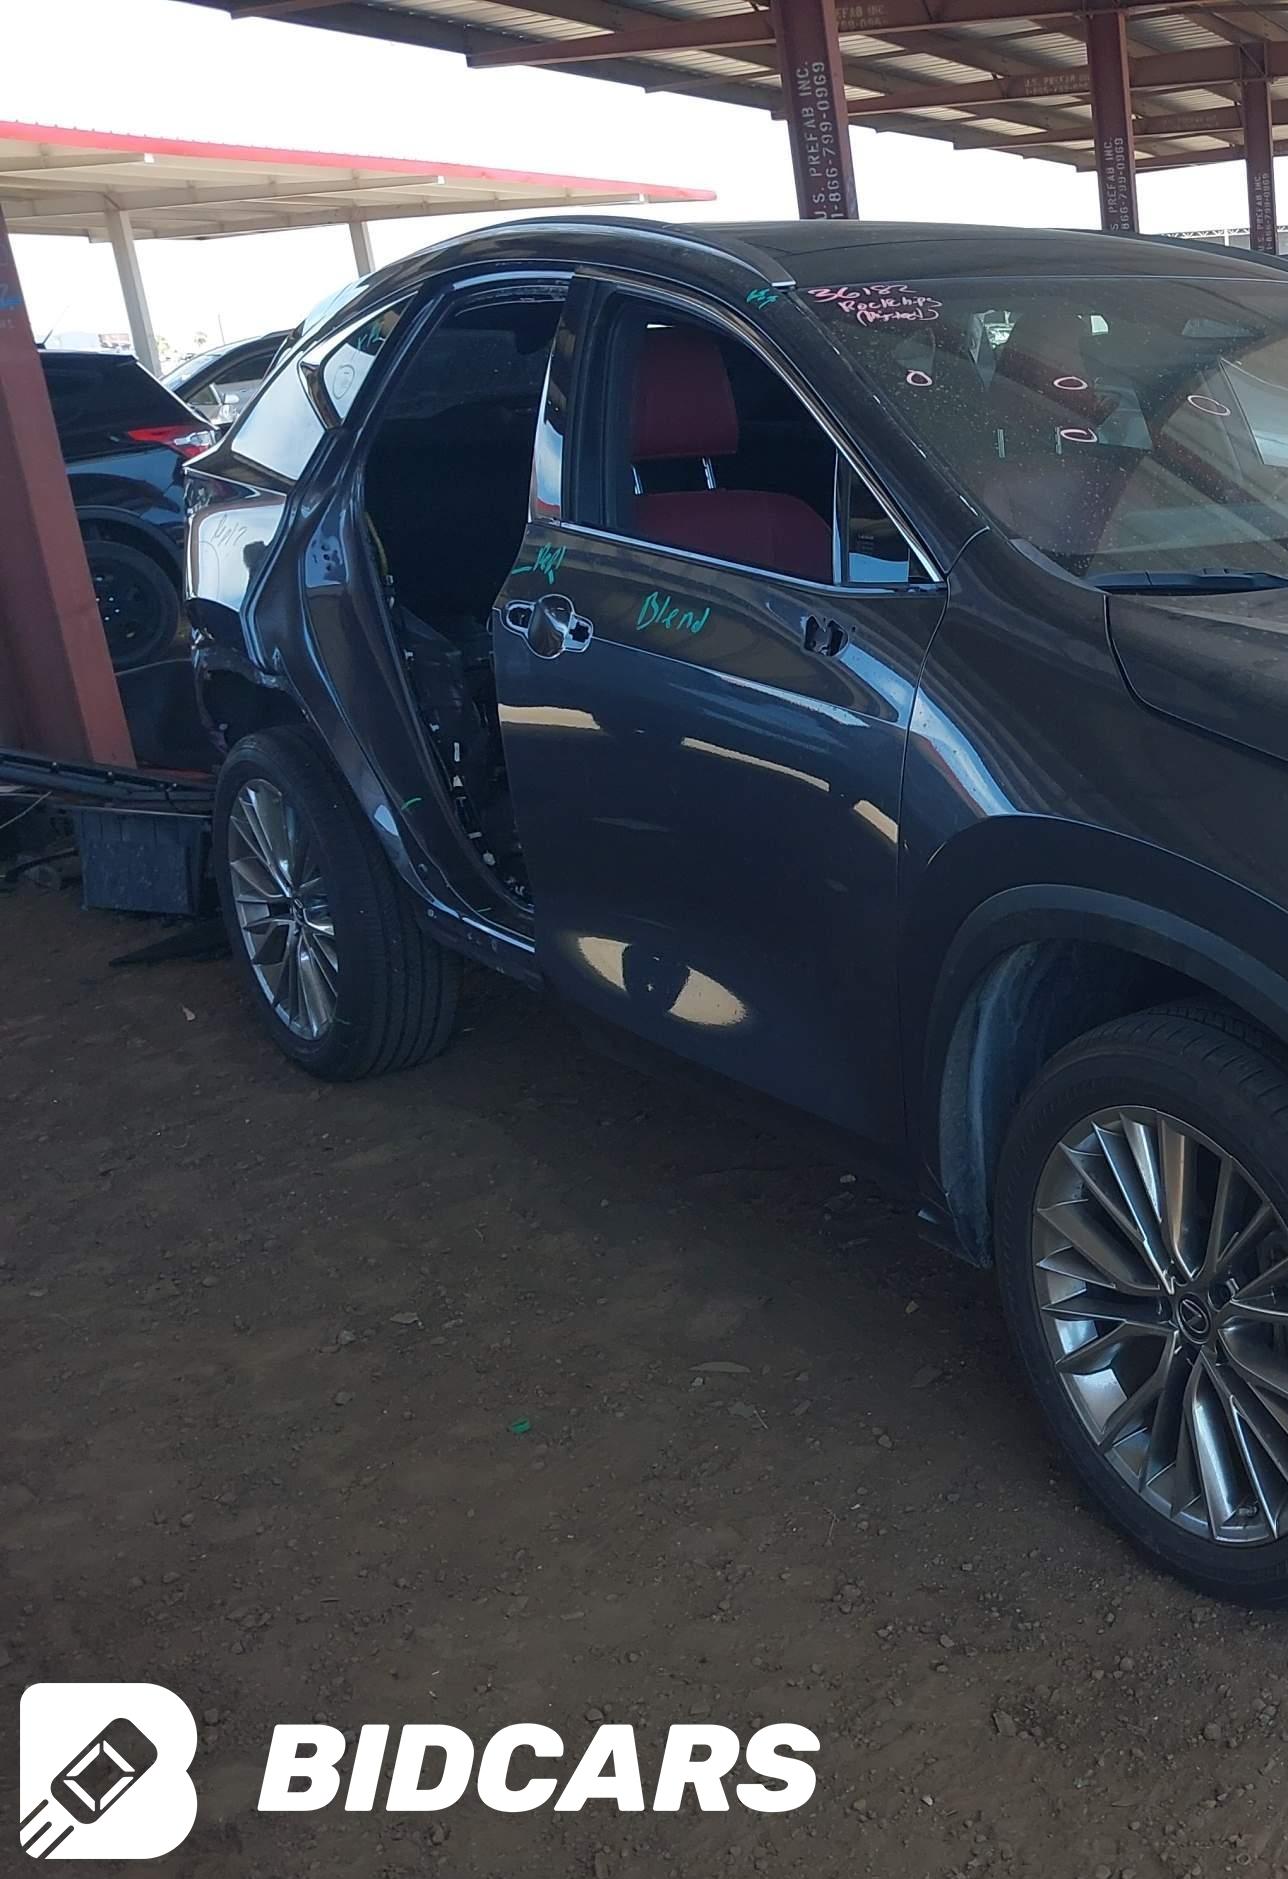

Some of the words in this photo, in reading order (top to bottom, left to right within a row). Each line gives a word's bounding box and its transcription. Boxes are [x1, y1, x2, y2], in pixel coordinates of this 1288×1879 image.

[796, 61, 812, 97] INC.
[802, 107, 822, 177] PREFAB
[812, 62, 844, 218] 1-866-799-0969
[1105, 167, 1118, 213] PREFAB
[1115, 137, 1130, 230] 866-799-0969
[636, 591, 711, 633] Blend
